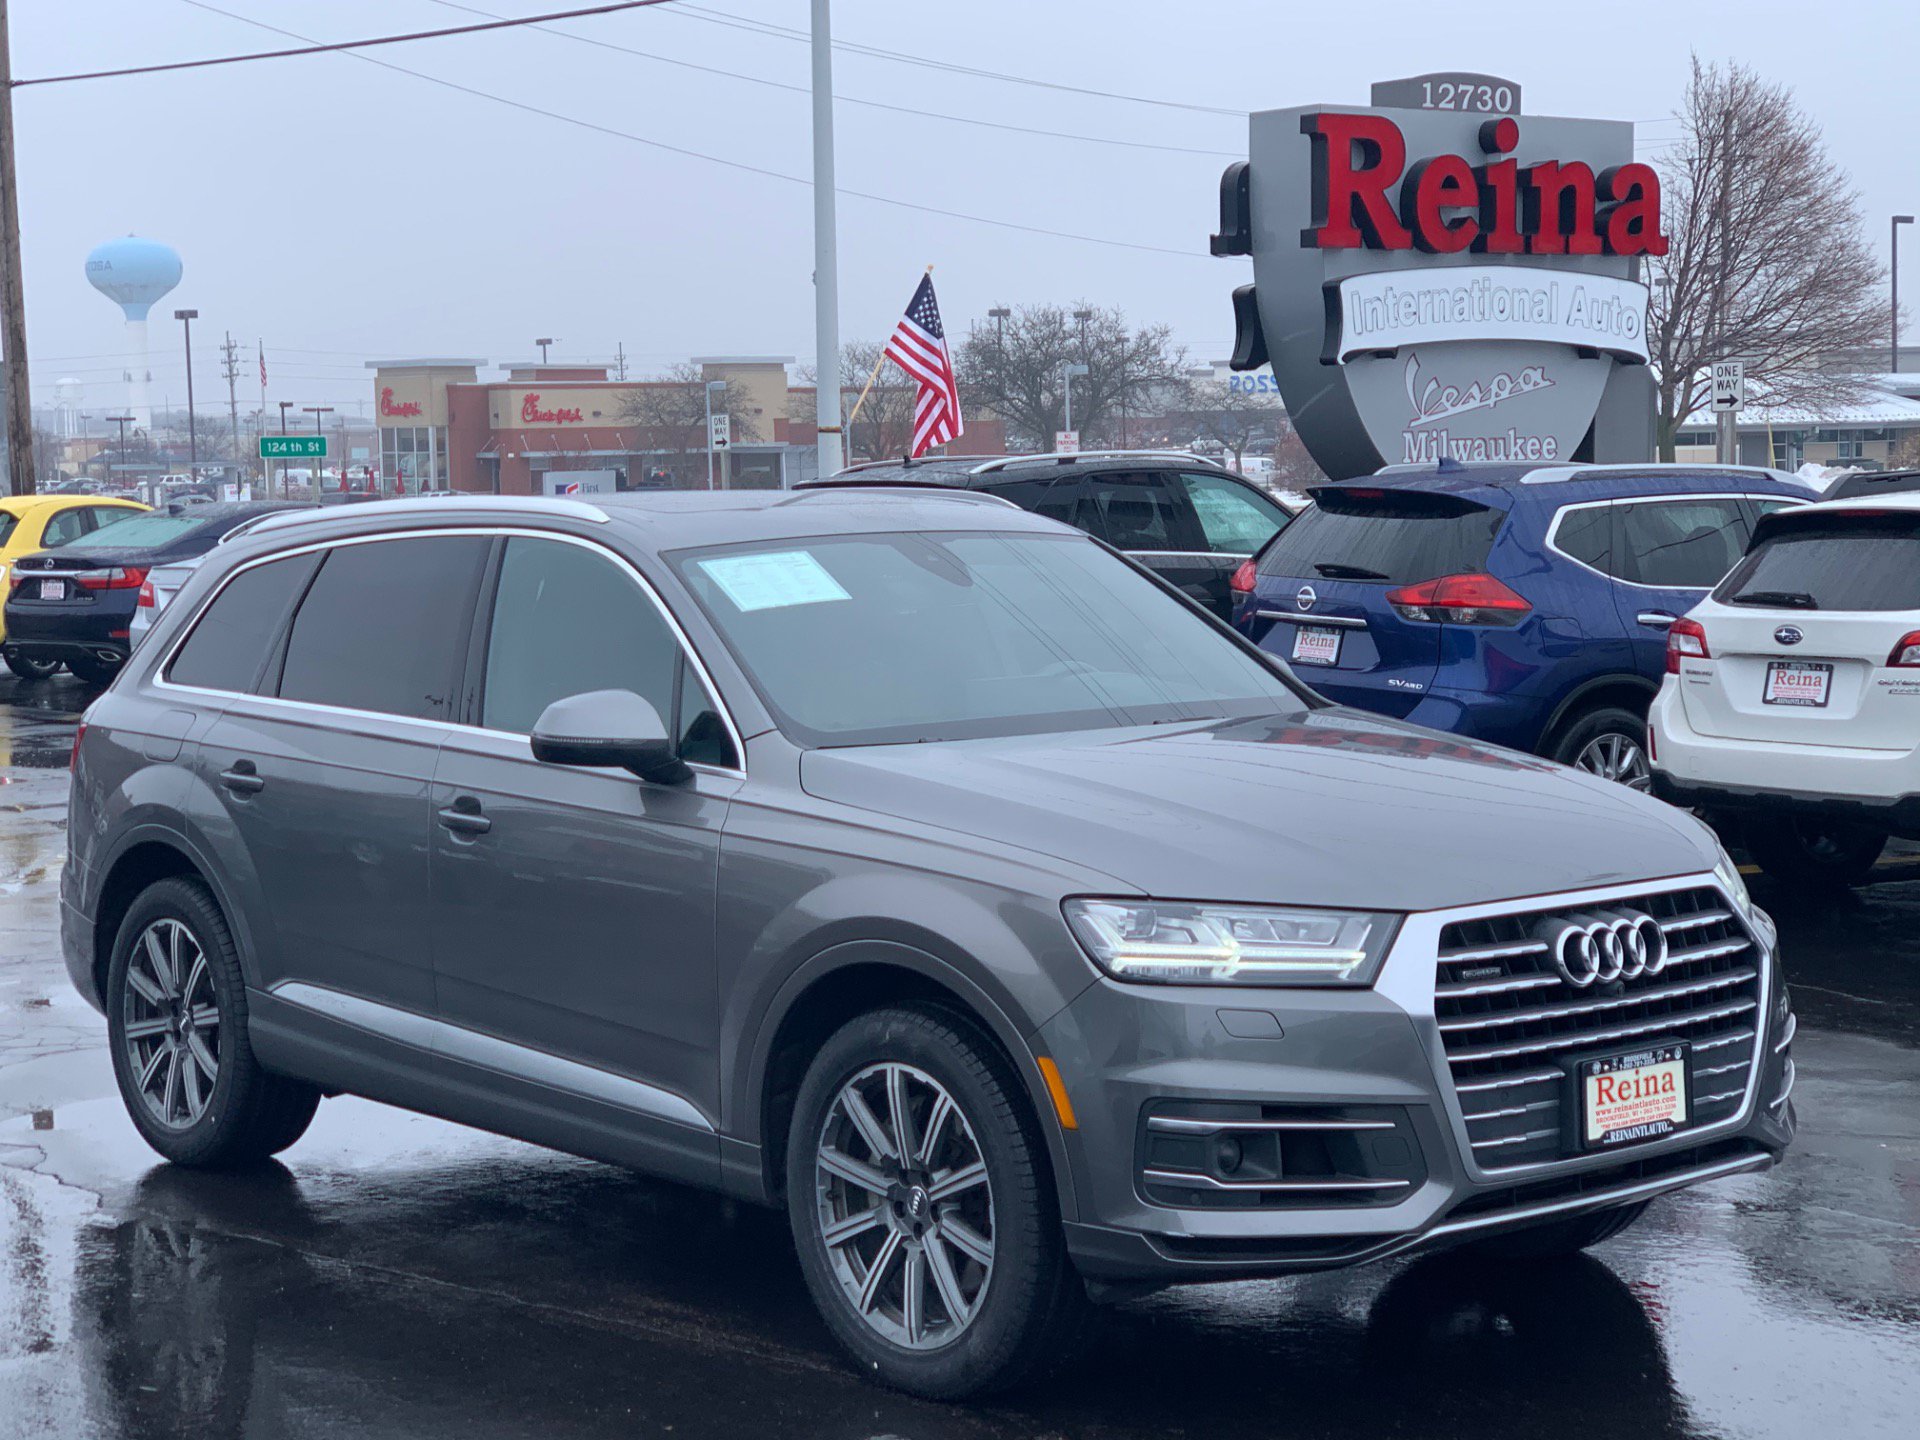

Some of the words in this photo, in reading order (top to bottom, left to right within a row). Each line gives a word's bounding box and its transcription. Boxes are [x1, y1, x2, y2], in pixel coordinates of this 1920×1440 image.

[1422, 81, 1513, 113] 12730
[1312, 112, 1669, 257] Reina
[1351, 276, 1559, 335] International
[1566, 285, 1641, 340] Auto
[1716, 365, 1739, 378] ONE
[1405, 352, 1557, 428] Vespa
[1716, 379, 1739, 391] WAY
[713, 416, 728, 426] ONE
[714, 426, 728, 436] WAY
[267, 441, 288, 453] 124
[290, 441, 303, 452] th
[307, 441, 321, 452] St
[1402, 427, 1558, 464] Milwaukee
[581, 482, 599, 494] First
[1299, 632, 1336, 648] Reina
[1774, 669, 1823, 688] Reina
[1595, 1069, 1675, 1107] Reina
